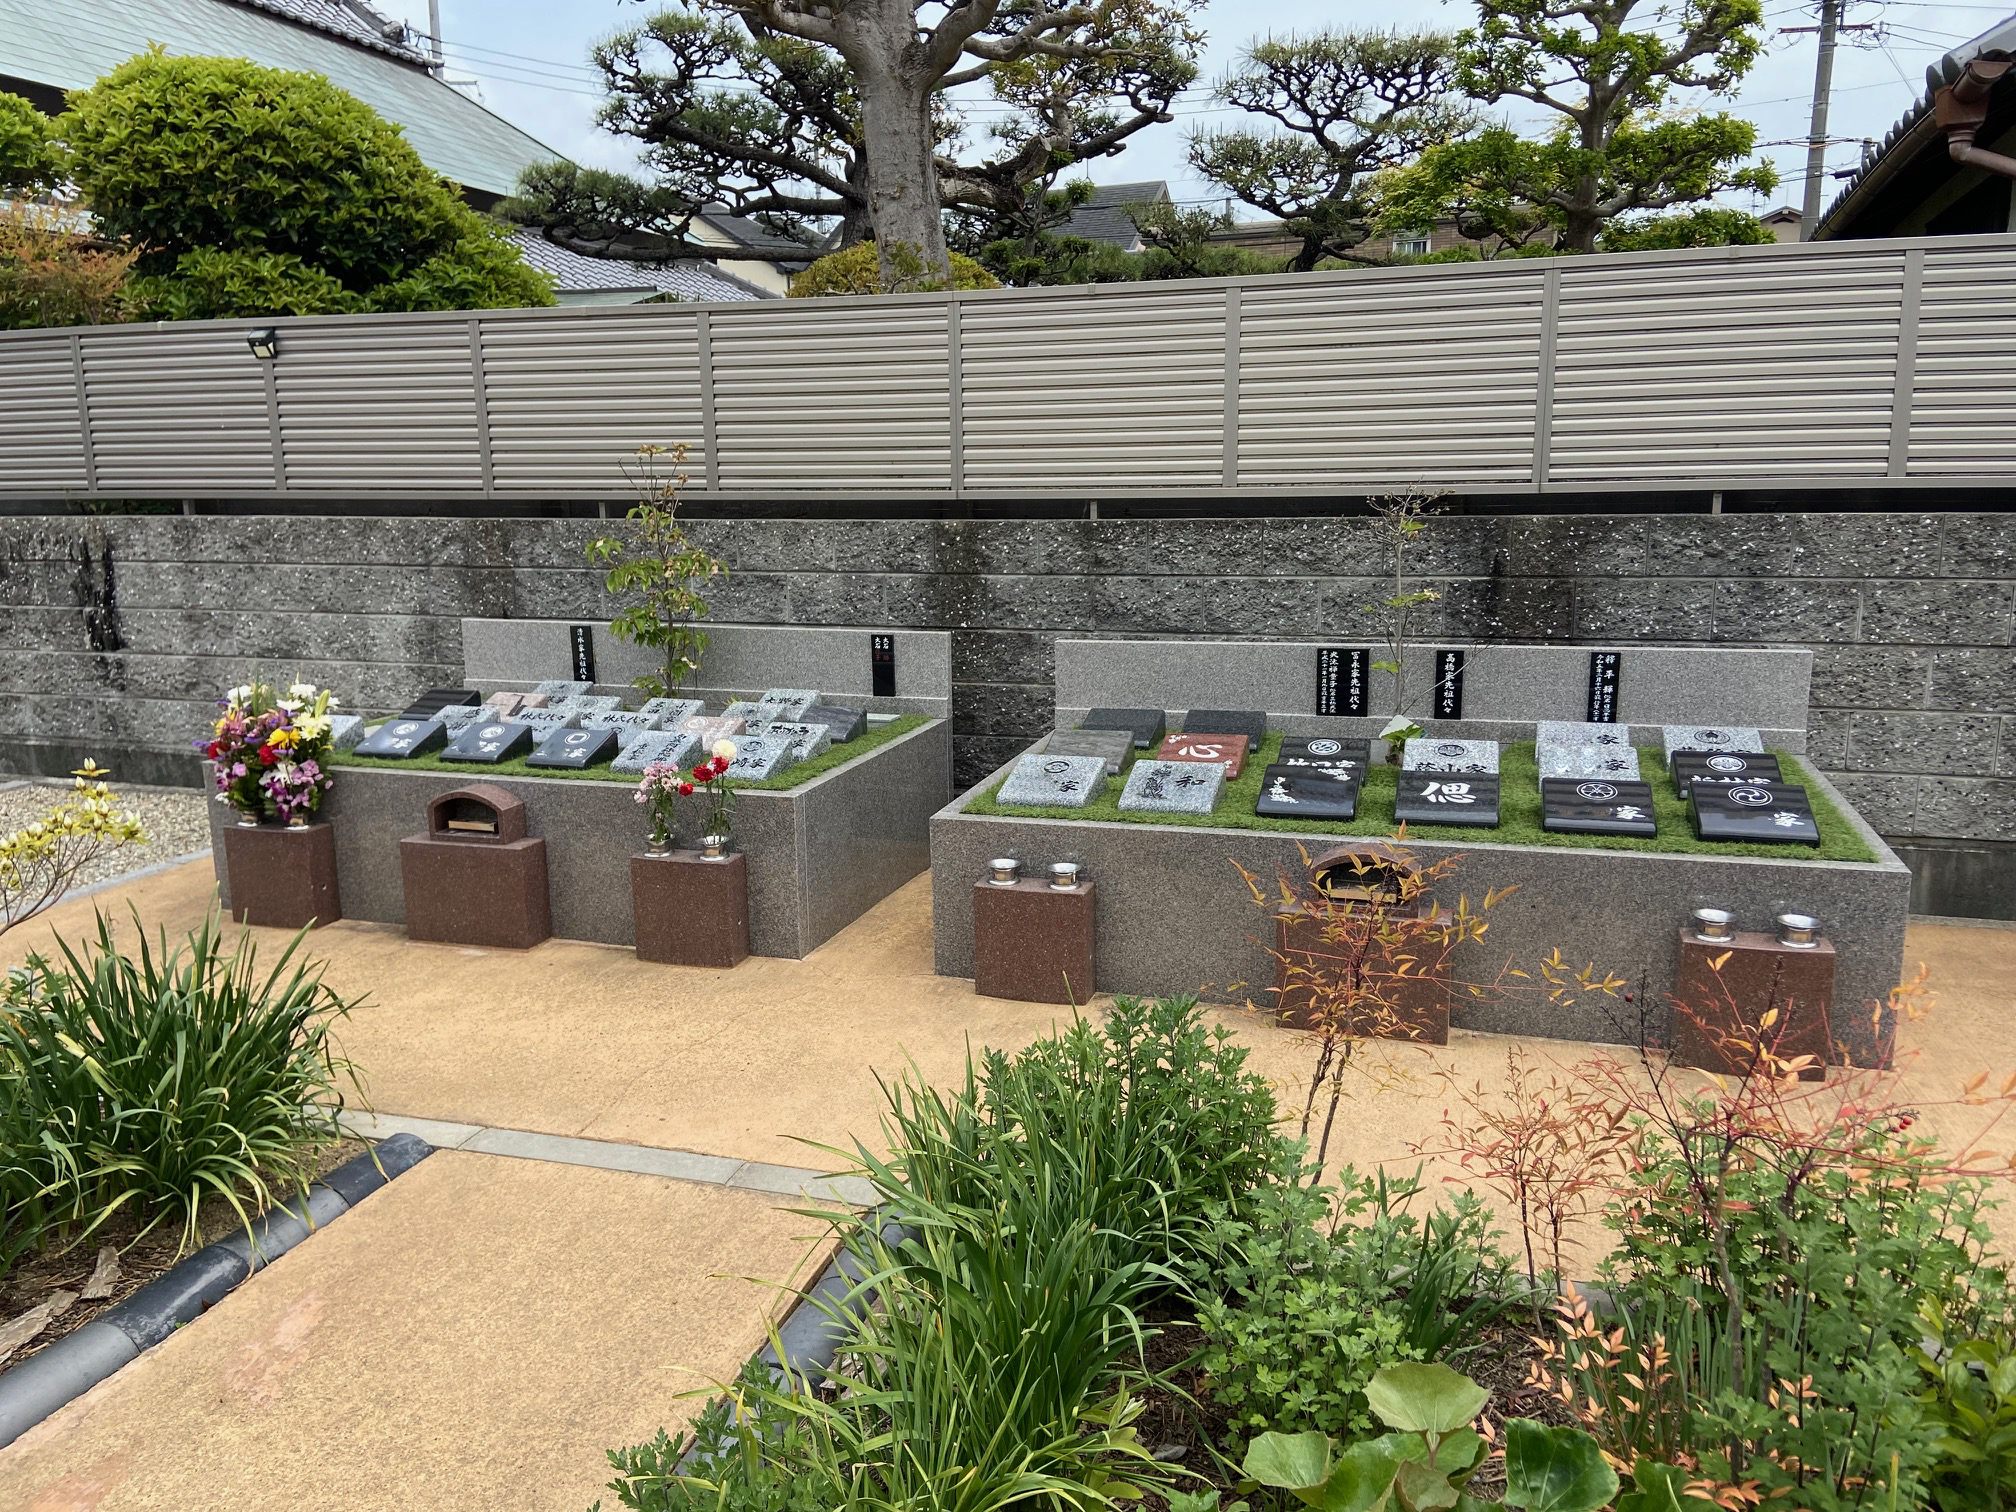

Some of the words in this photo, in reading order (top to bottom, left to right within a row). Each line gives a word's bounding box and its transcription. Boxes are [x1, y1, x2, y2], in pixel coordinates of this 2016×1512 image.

[577, 628, 588, 680] 清水家先祖代々
[1177, 744, 1223, 758] 心
[1175, 775, 1206, 788] 和
